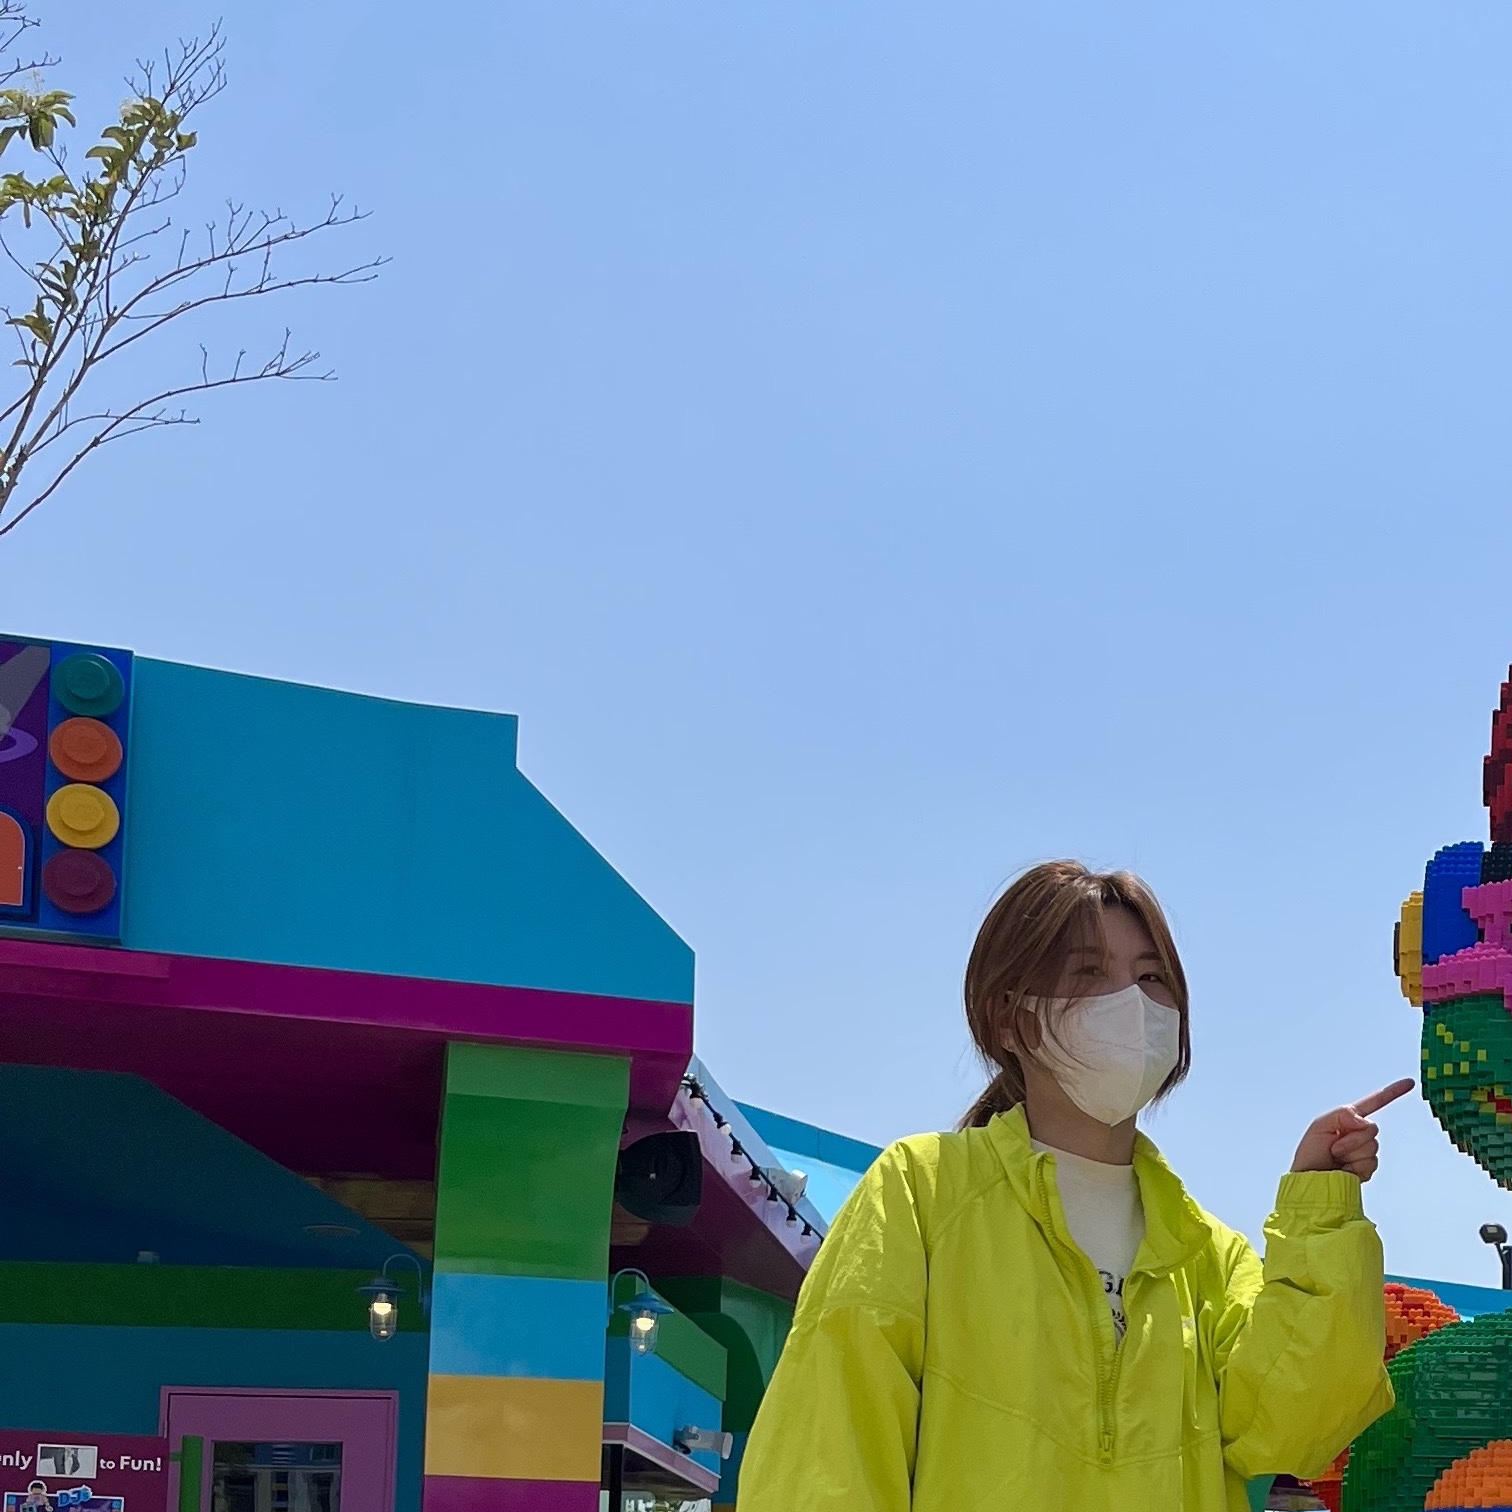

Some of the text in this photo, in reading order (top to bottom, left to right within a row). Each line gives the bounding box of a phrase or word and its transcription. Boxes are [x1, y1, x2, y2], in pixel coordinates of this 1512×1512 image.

[0, 1450, 162, 1472] nly to Fun!
